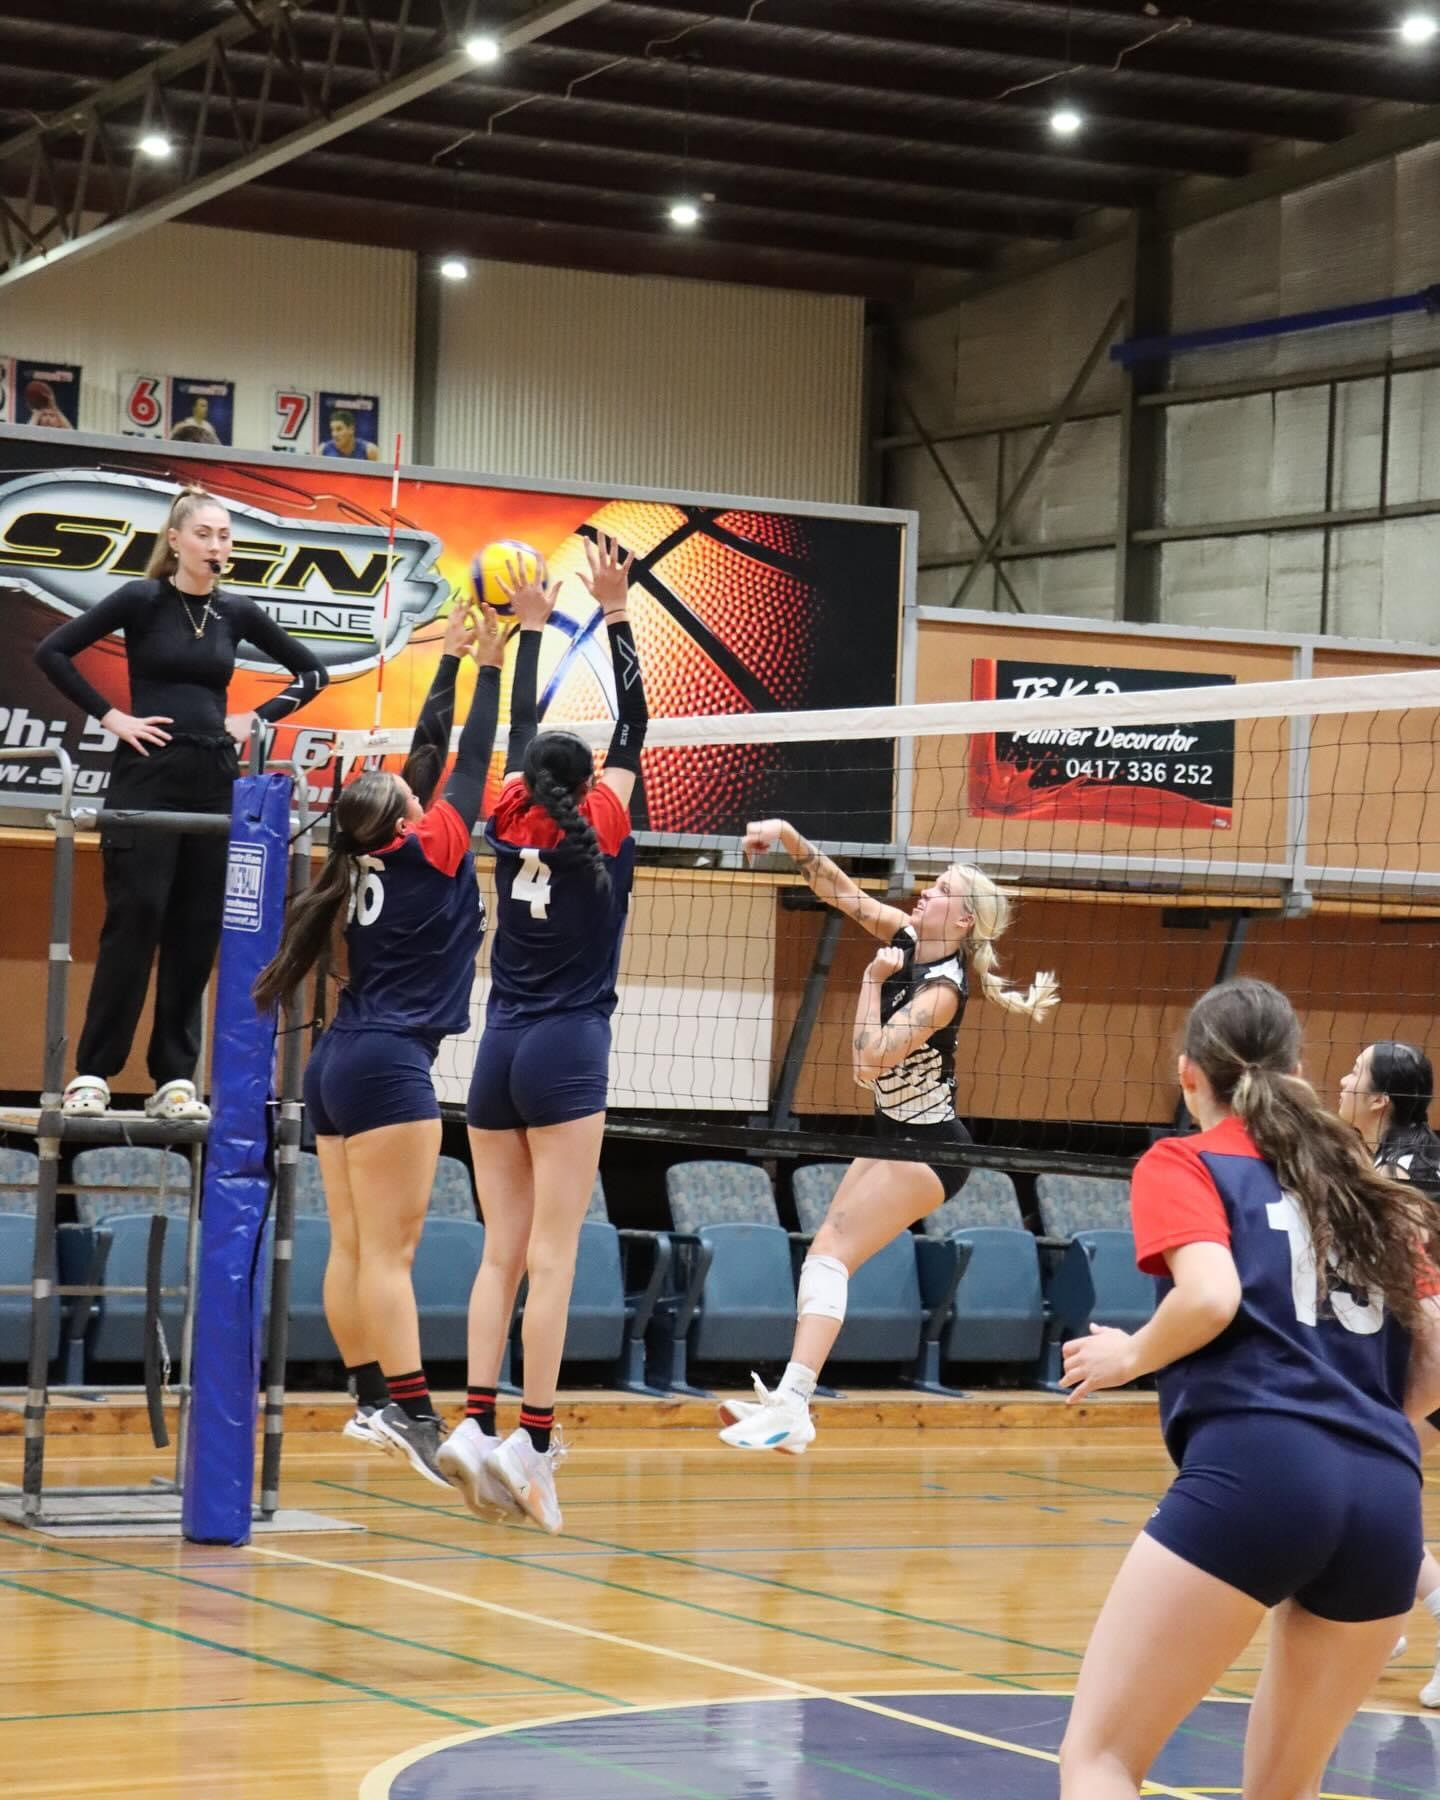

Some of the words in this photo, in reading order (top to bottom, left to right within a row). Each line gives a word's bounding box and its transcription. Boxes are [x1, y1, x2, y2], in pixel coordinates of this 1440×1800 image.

[127, 377, 161, 428] 6
[276, 391, 310, 440] 7
[1012, 727, 1092, 747] Painter
[1094, 726, 1199, 752] Decorator
[1065, 758, 1120, 780] 0417
[1127, 761, 1168, 783] 336
[1173, 763, 1213, 785] 252
[511, 848, 552, 920] 4
